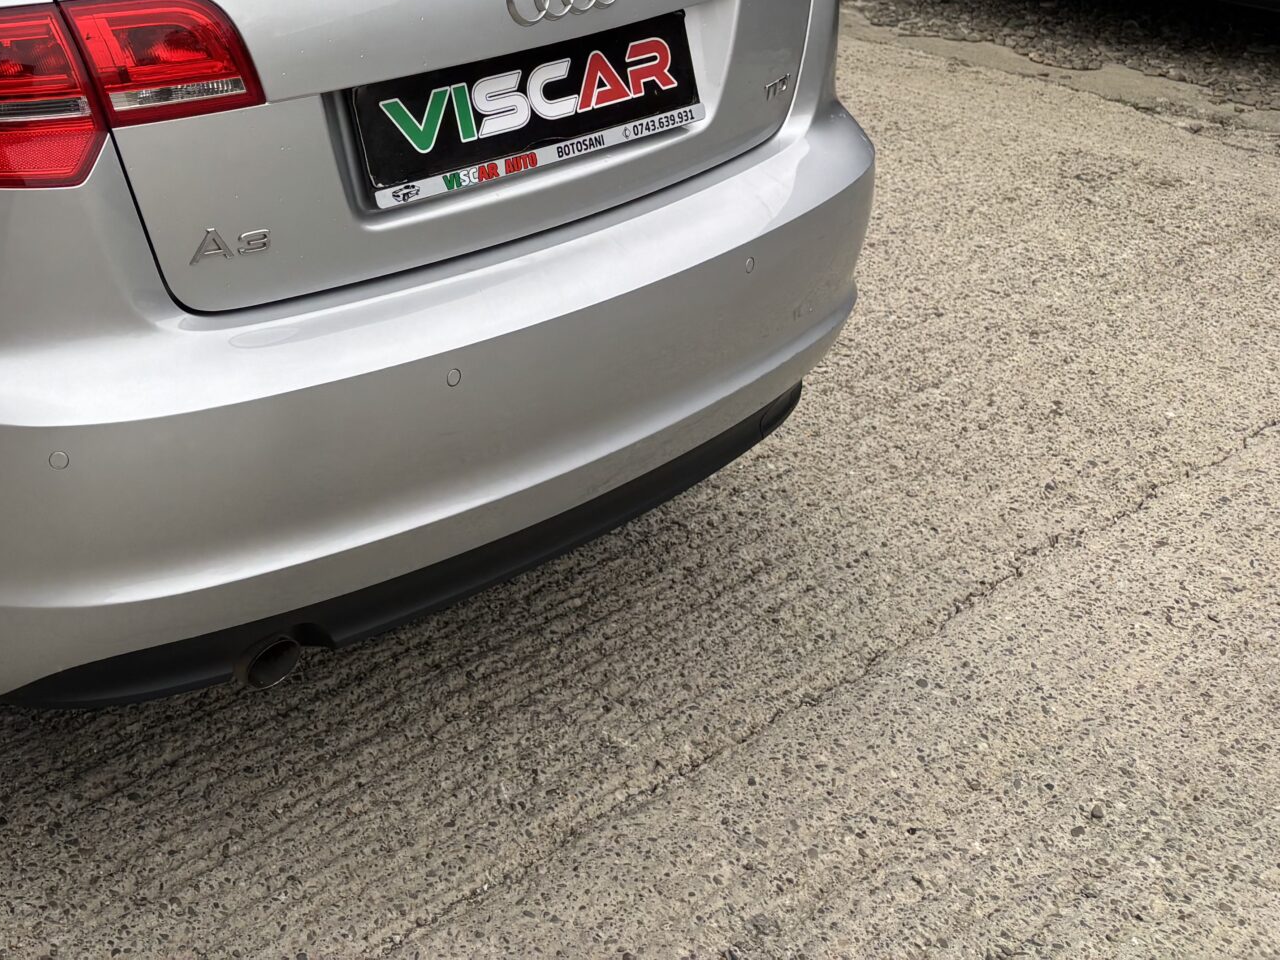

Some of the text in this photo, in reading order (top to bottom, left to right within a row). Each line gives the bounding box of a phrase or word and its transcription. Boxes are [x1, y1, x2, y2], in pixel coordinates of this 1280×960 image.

[379, 37, 678, 154] VISCAR
[442, 108, 695, 190] VISCAR AUTO BOTOSANI 0743.639.931
[189, 228, 270, 266] A3
